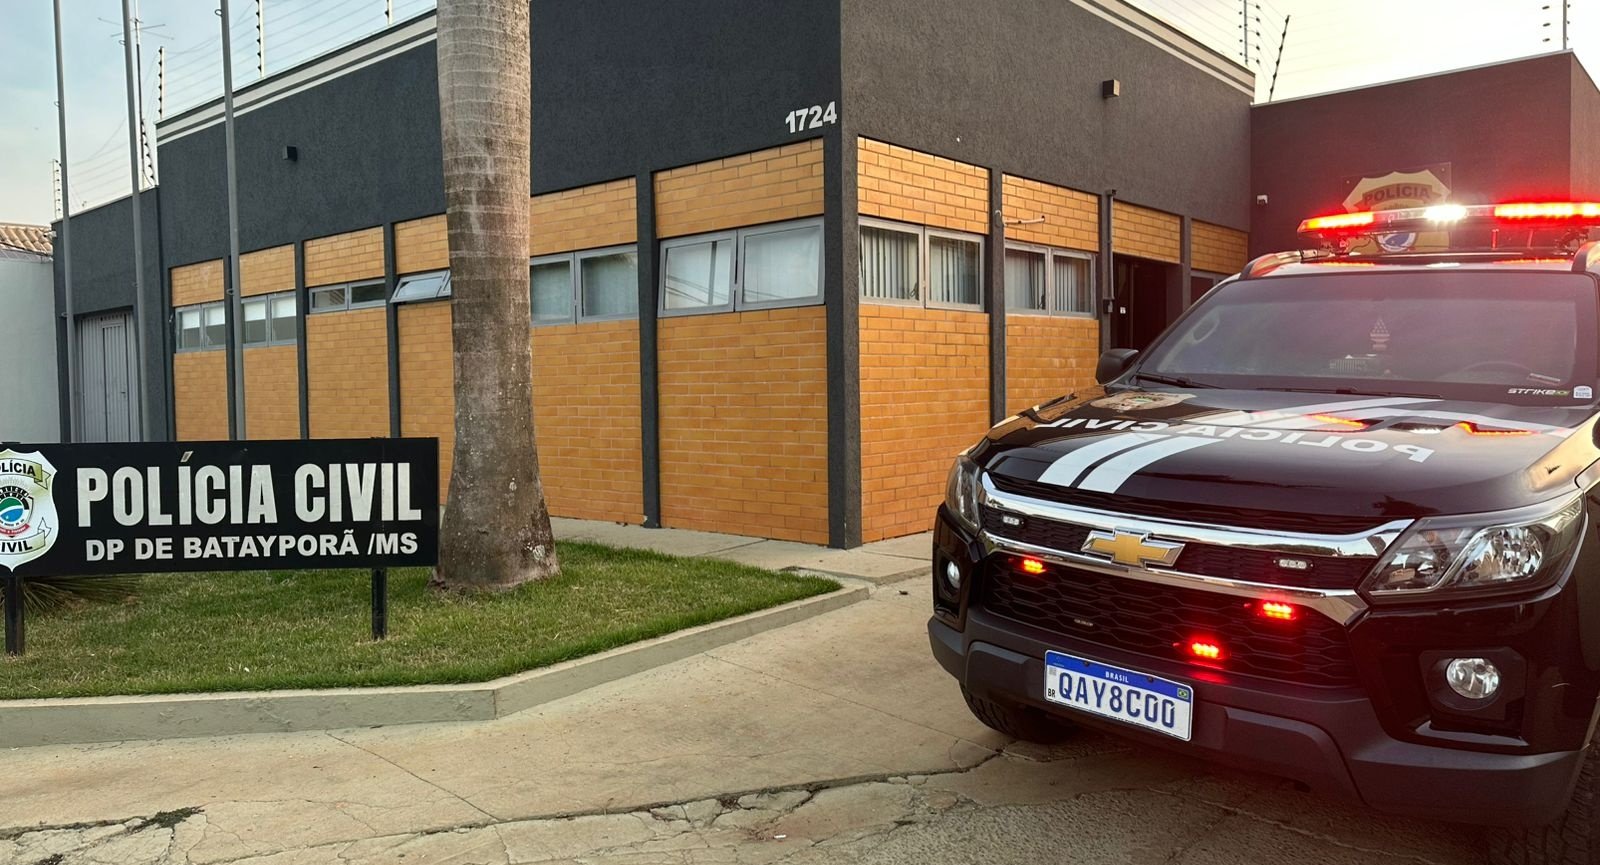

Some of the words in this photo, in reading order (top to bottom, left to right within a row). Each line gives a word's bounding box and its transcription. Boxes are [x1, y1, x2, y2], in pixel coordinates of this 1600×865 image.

[785, 101, 837, 133] 1724
[0, 460, 37, 476] LÍCIA
[77, 450, 278, 527] POLÍCIA
[294, 462, 422, 523] CIVIL
[0, 540, 33, 553] IVIL
[86, 539, 125, 561] DP
[134, 537, 174, 560] DE
[184, 530, 359, 559] BATAYPORÃ
[367, 532, 419, 555] /MS
[1105, 671, 1129, 683] BRASIL
[1047, 688, 1056, 698] BR
[1059, 672, 1175, 728] QAY8C00
